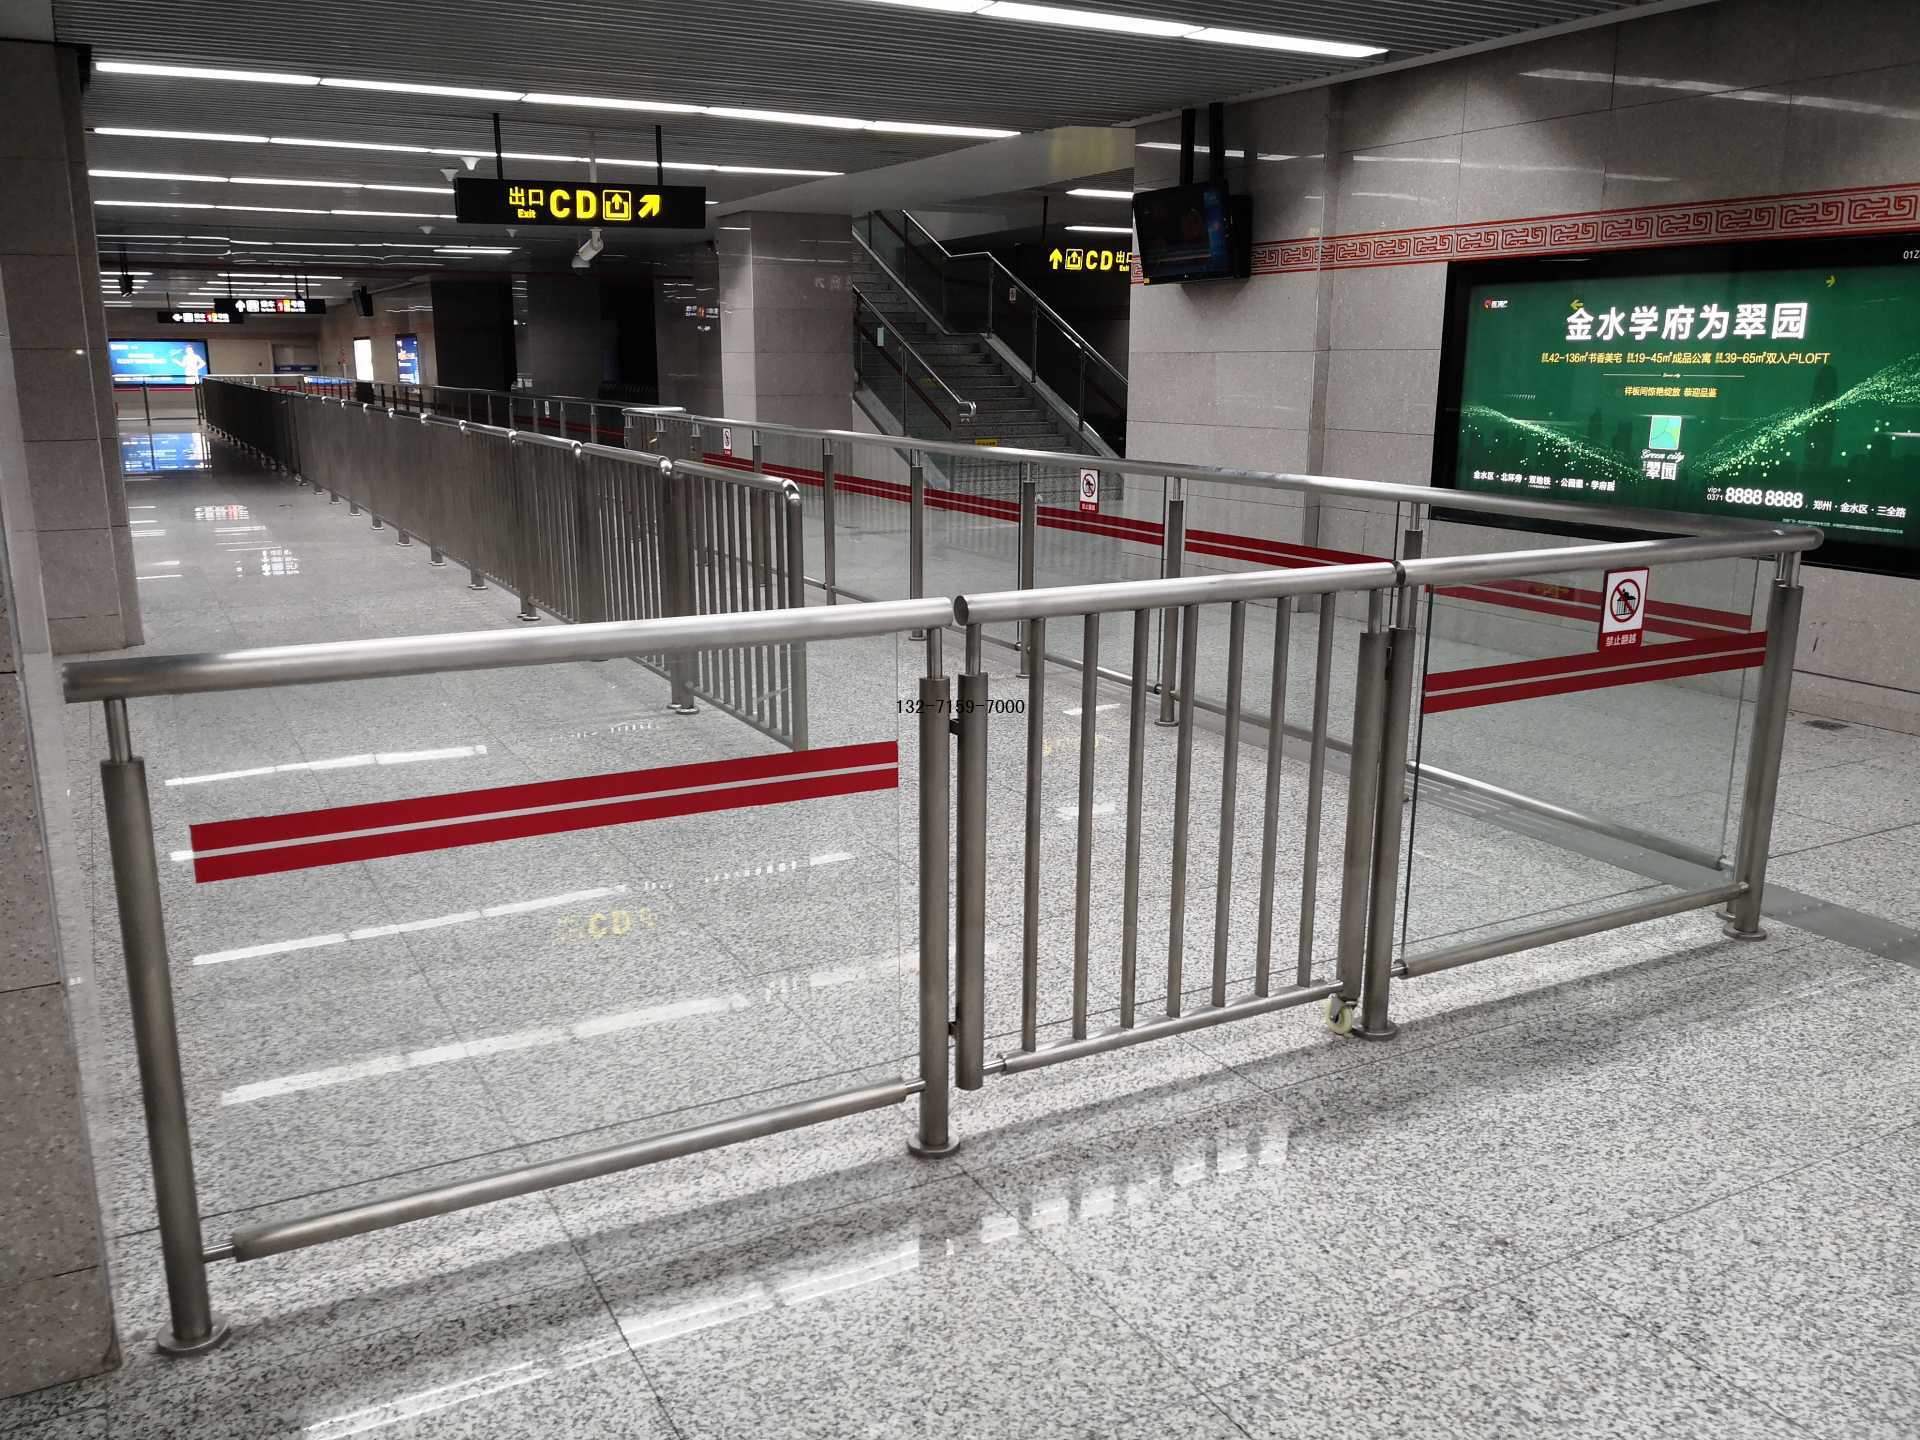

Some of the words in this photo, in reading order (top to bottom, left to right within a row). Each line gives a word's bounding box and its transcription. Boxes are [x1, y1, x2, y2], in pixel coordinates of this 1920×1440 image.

[509, 186, 543, 206] 出口
[518, 209, 536, 218] Exit
[1566, 303, 1808, 340] 金水学府为翠园
[1646, 461, 1677, 480] 翠园
[1707, 493, 1723, 501] 0371
[1725, 487, 1762, 505] 8888
[1765, 490, 1803, 508] 8888
